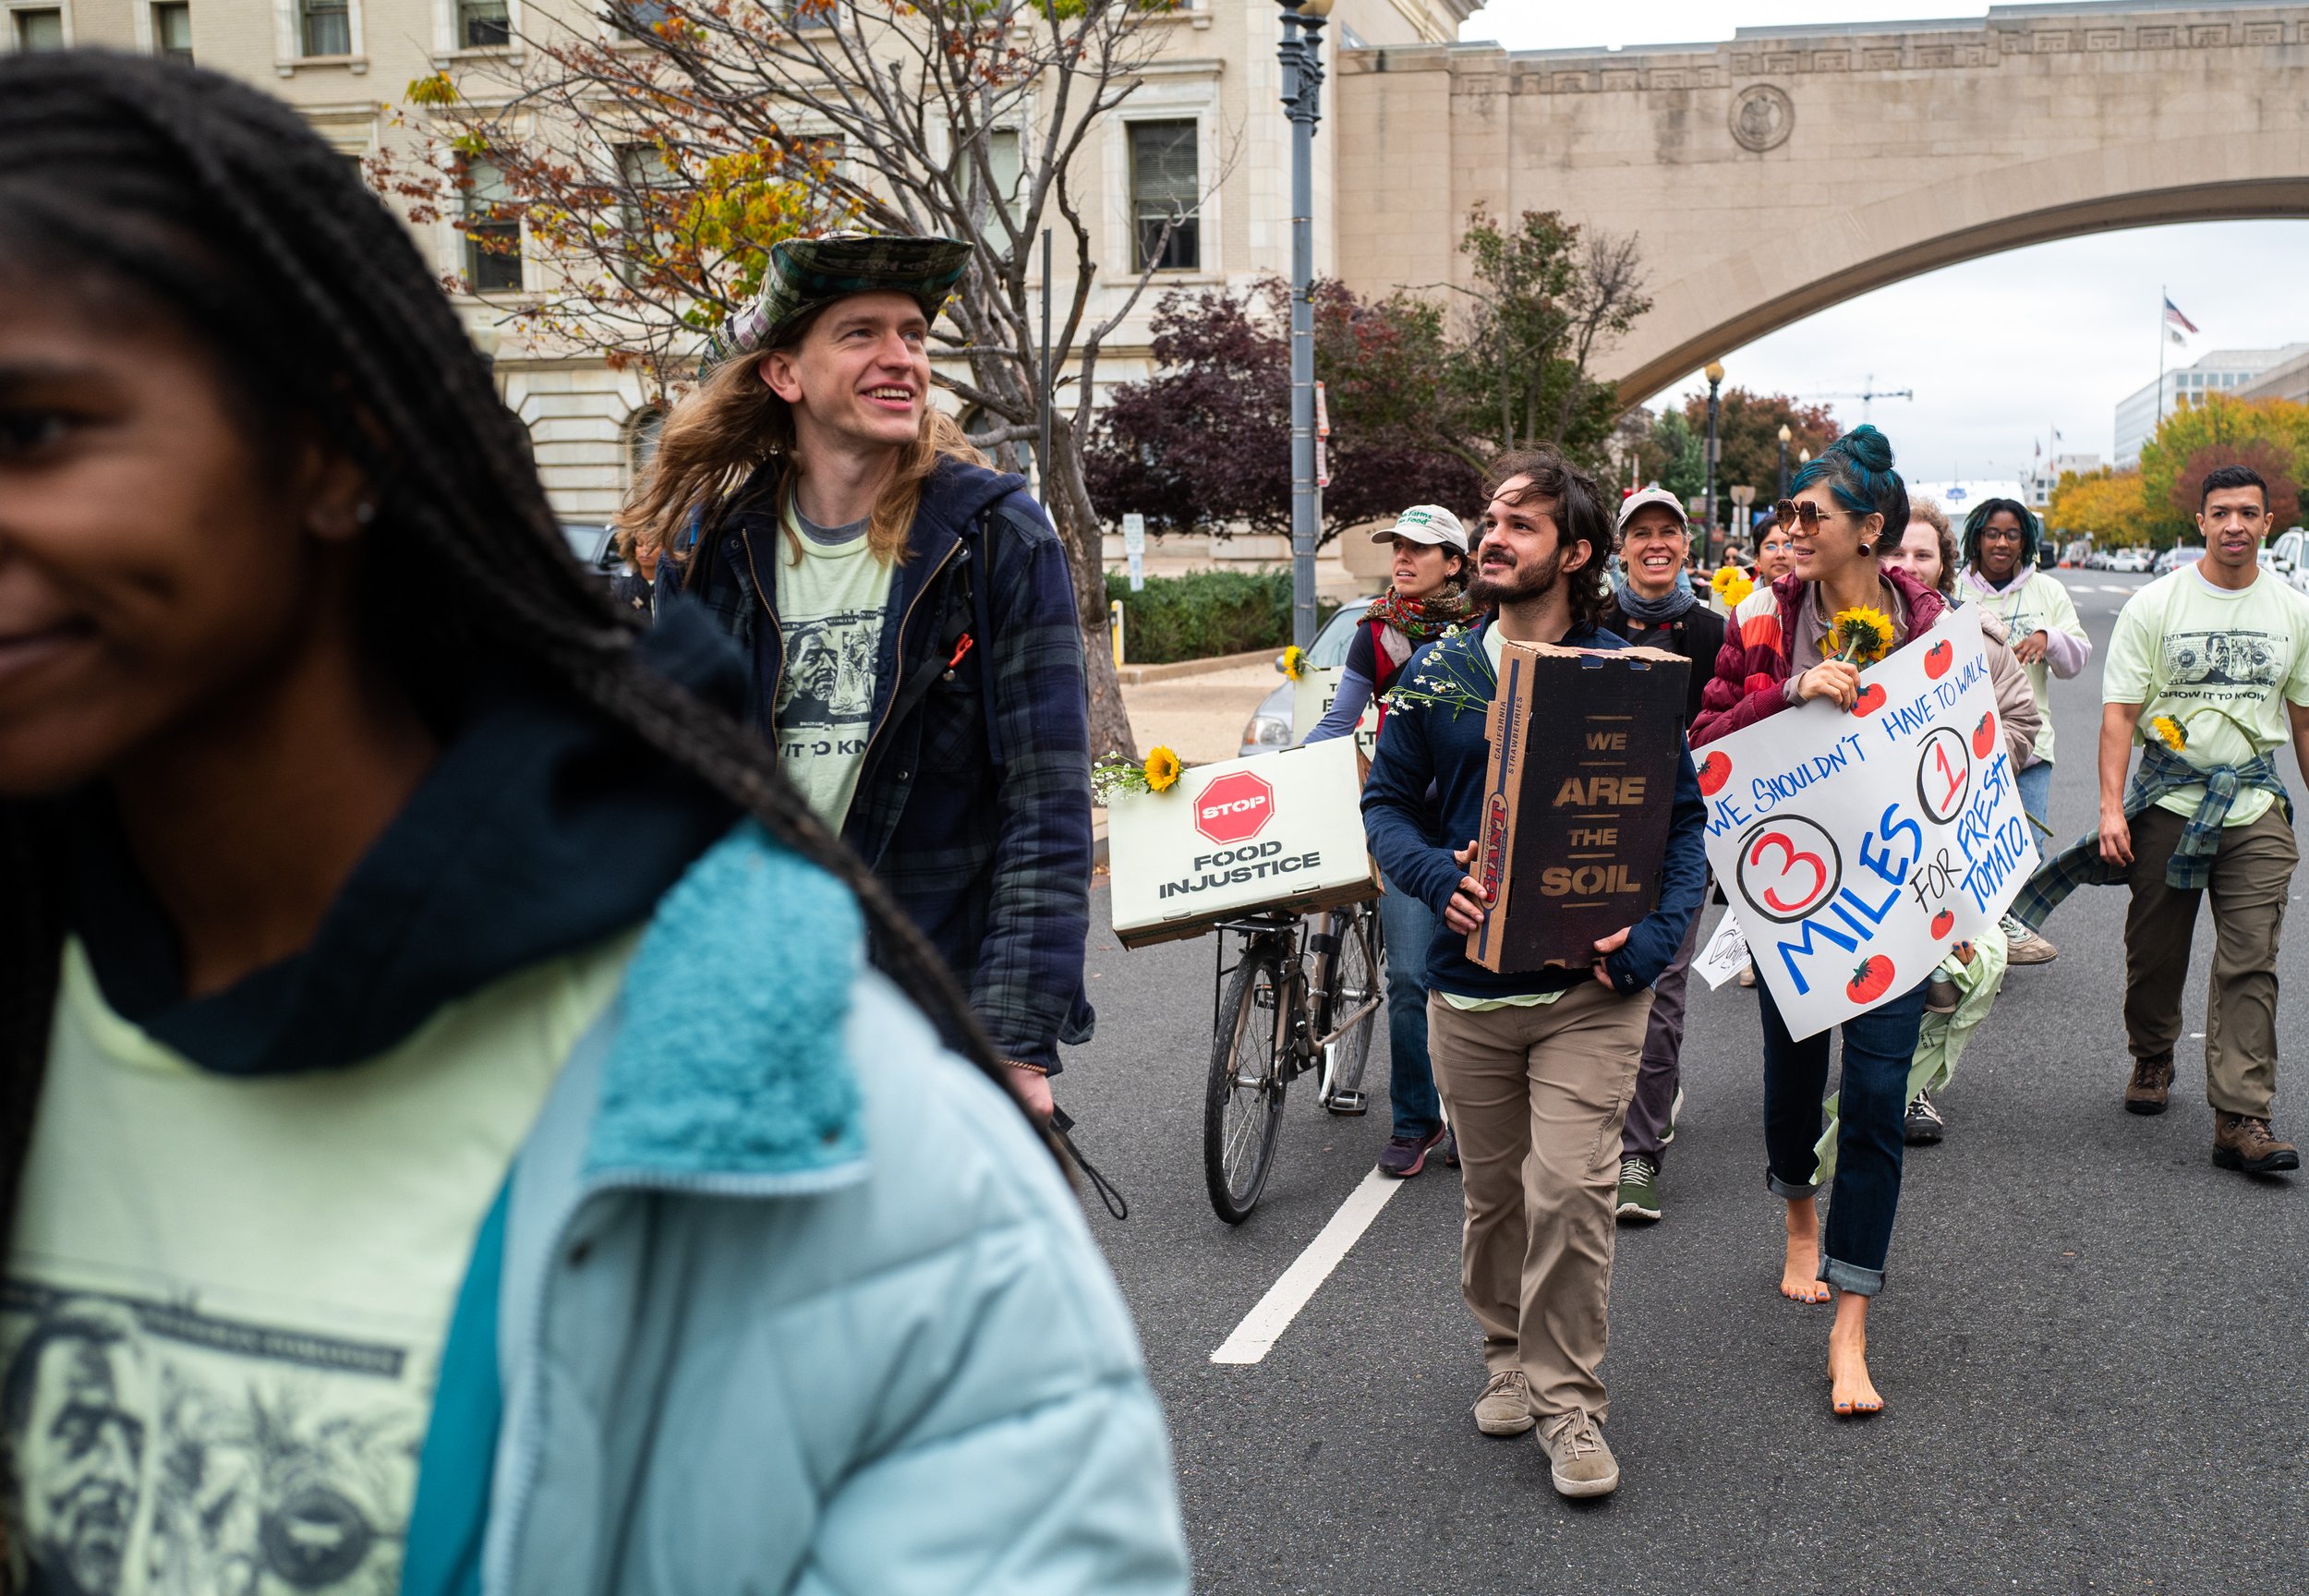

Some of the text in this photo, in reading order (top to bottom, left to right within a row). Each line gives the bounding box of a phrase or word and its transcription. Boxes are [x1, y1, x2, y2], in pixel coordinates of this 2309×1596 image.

[1408, 511, 1433, 520] Farms
[2203, 691, 2215, 700] IT
[785, 744, 804, 757] IT
[810, 741, 831, 757] TO
[1494, 700, 1507, 760] CALIFORNIA
[1507, 695, 1523, 775] STRAWBERRIES
[1586, 732, 1627, 750] WE
[1705, 653, 1988, 837] WE SHOULDN'T HAVE TO WALK
[1202, 795, 1266, 819] STOP
[1552, 777, 1646, 807] ARE
[1956, 753, 2011, 862] FRESH
[1567, 828, 1618, 847] THE
[1909, 742, 1966, 913] FOR 1
[1194, 840, 1282, 871] FOOD
[1483, 800, 1506, 903] GIANT
[1961, 816, 2028, 914] TOMATO.
[1159, 852, 1321, 899] INJUSTICE
[1541, 864, 1641, 897] SOIL
[1751, 803, 1922, 995] 3 MILES
